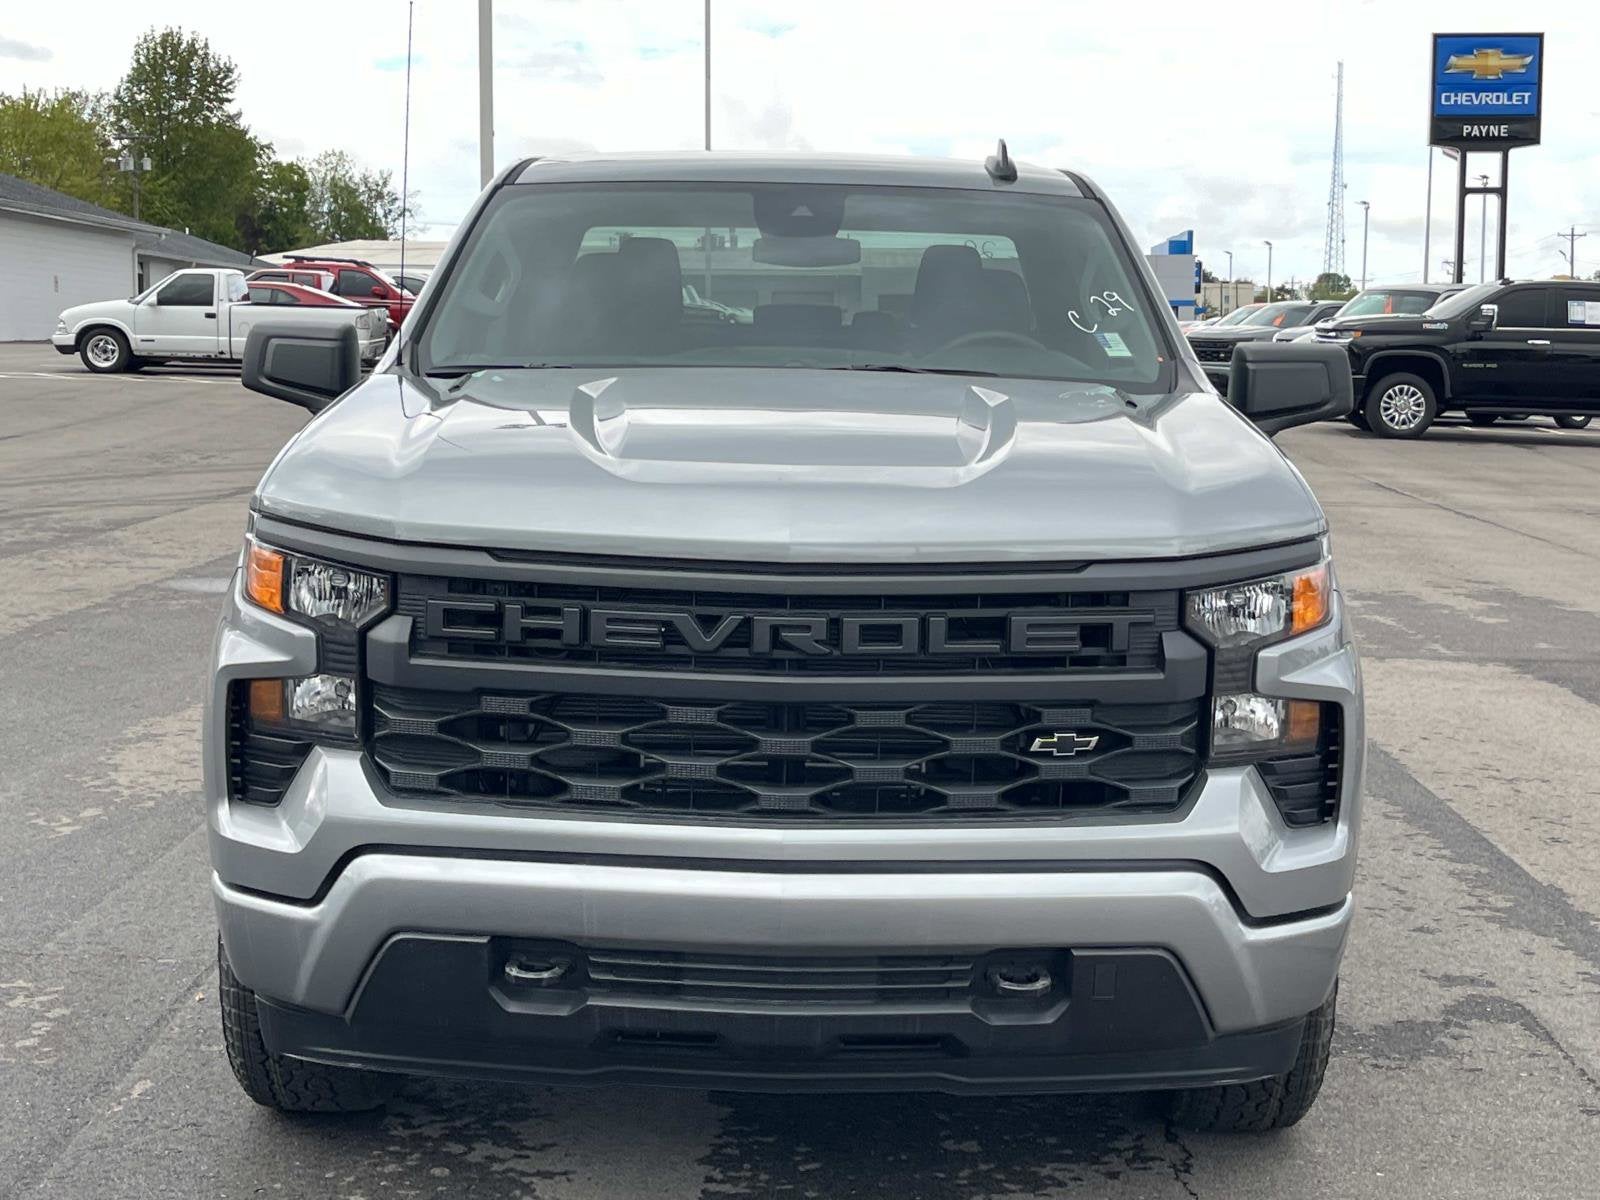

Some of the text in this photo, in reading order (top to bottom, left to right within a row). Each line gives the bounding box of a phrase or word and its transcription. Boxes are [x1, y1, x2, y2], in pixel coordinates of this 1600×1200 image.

[1441, 92, 1531, 105] CHEVROLET
[1463, 125, 1508, 137] PAYNE
[426, 599, 1155, 656] CHEVROLET
